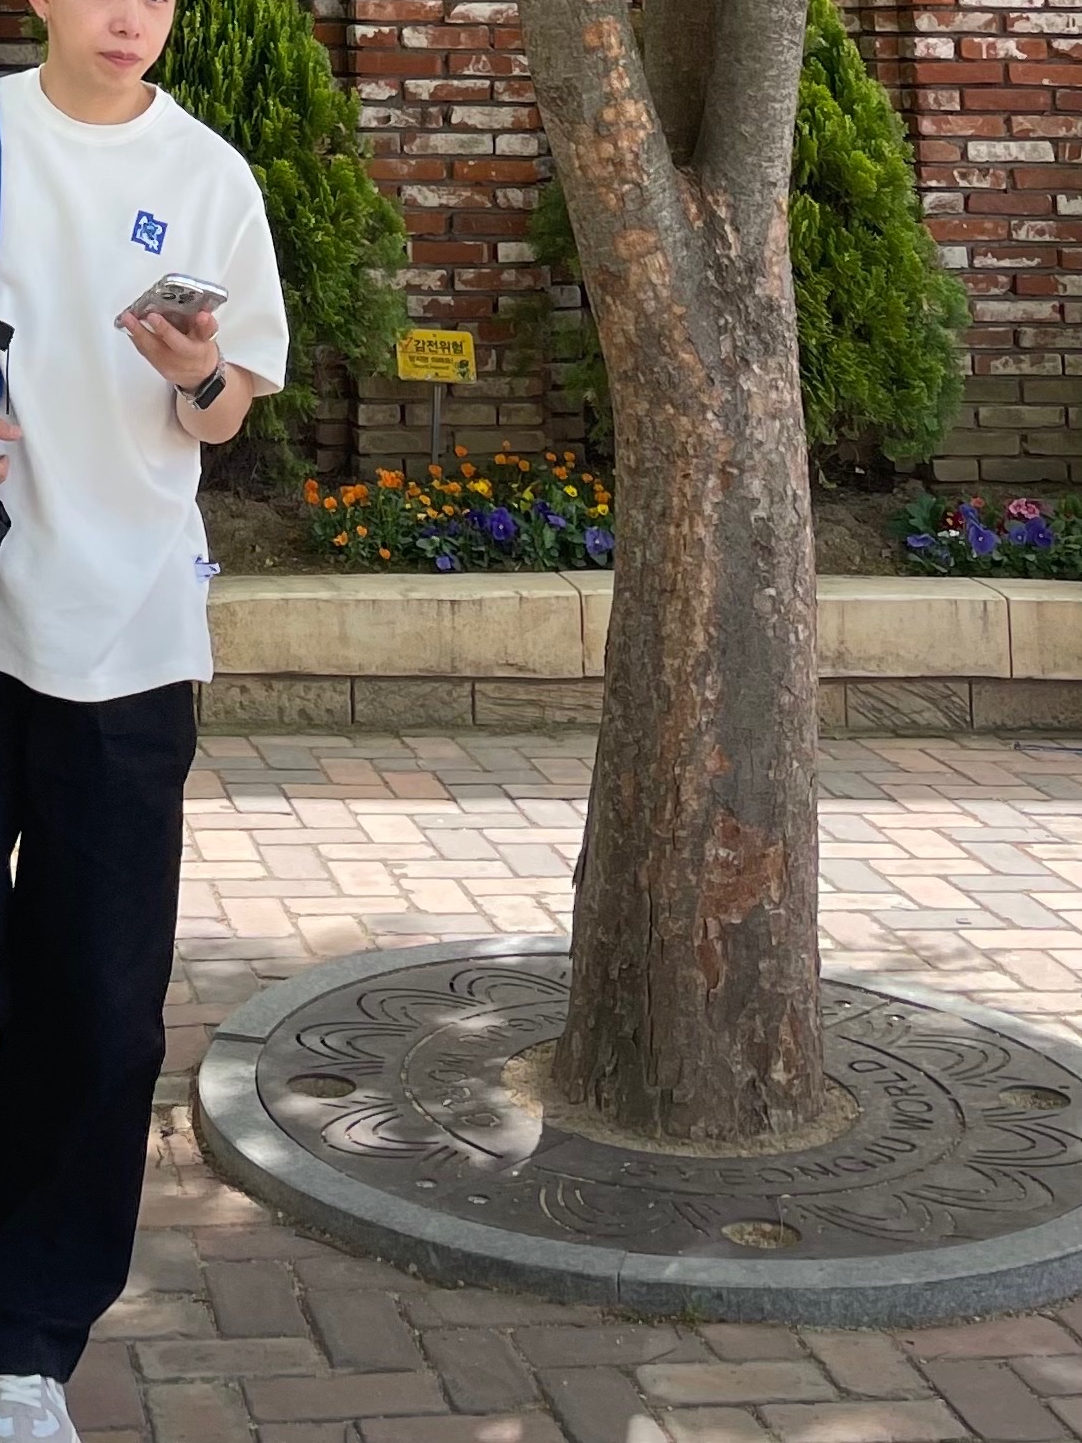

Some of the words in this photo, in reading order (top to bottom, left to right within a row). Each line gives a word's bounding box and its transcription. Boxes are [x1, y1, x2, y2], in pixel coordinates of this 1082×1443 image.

[413, 339, 463, 355] 감전위험
[621, 1135, 917, 1186] GYEONGJU
[848, 1059, 934, 1131] WORLD
